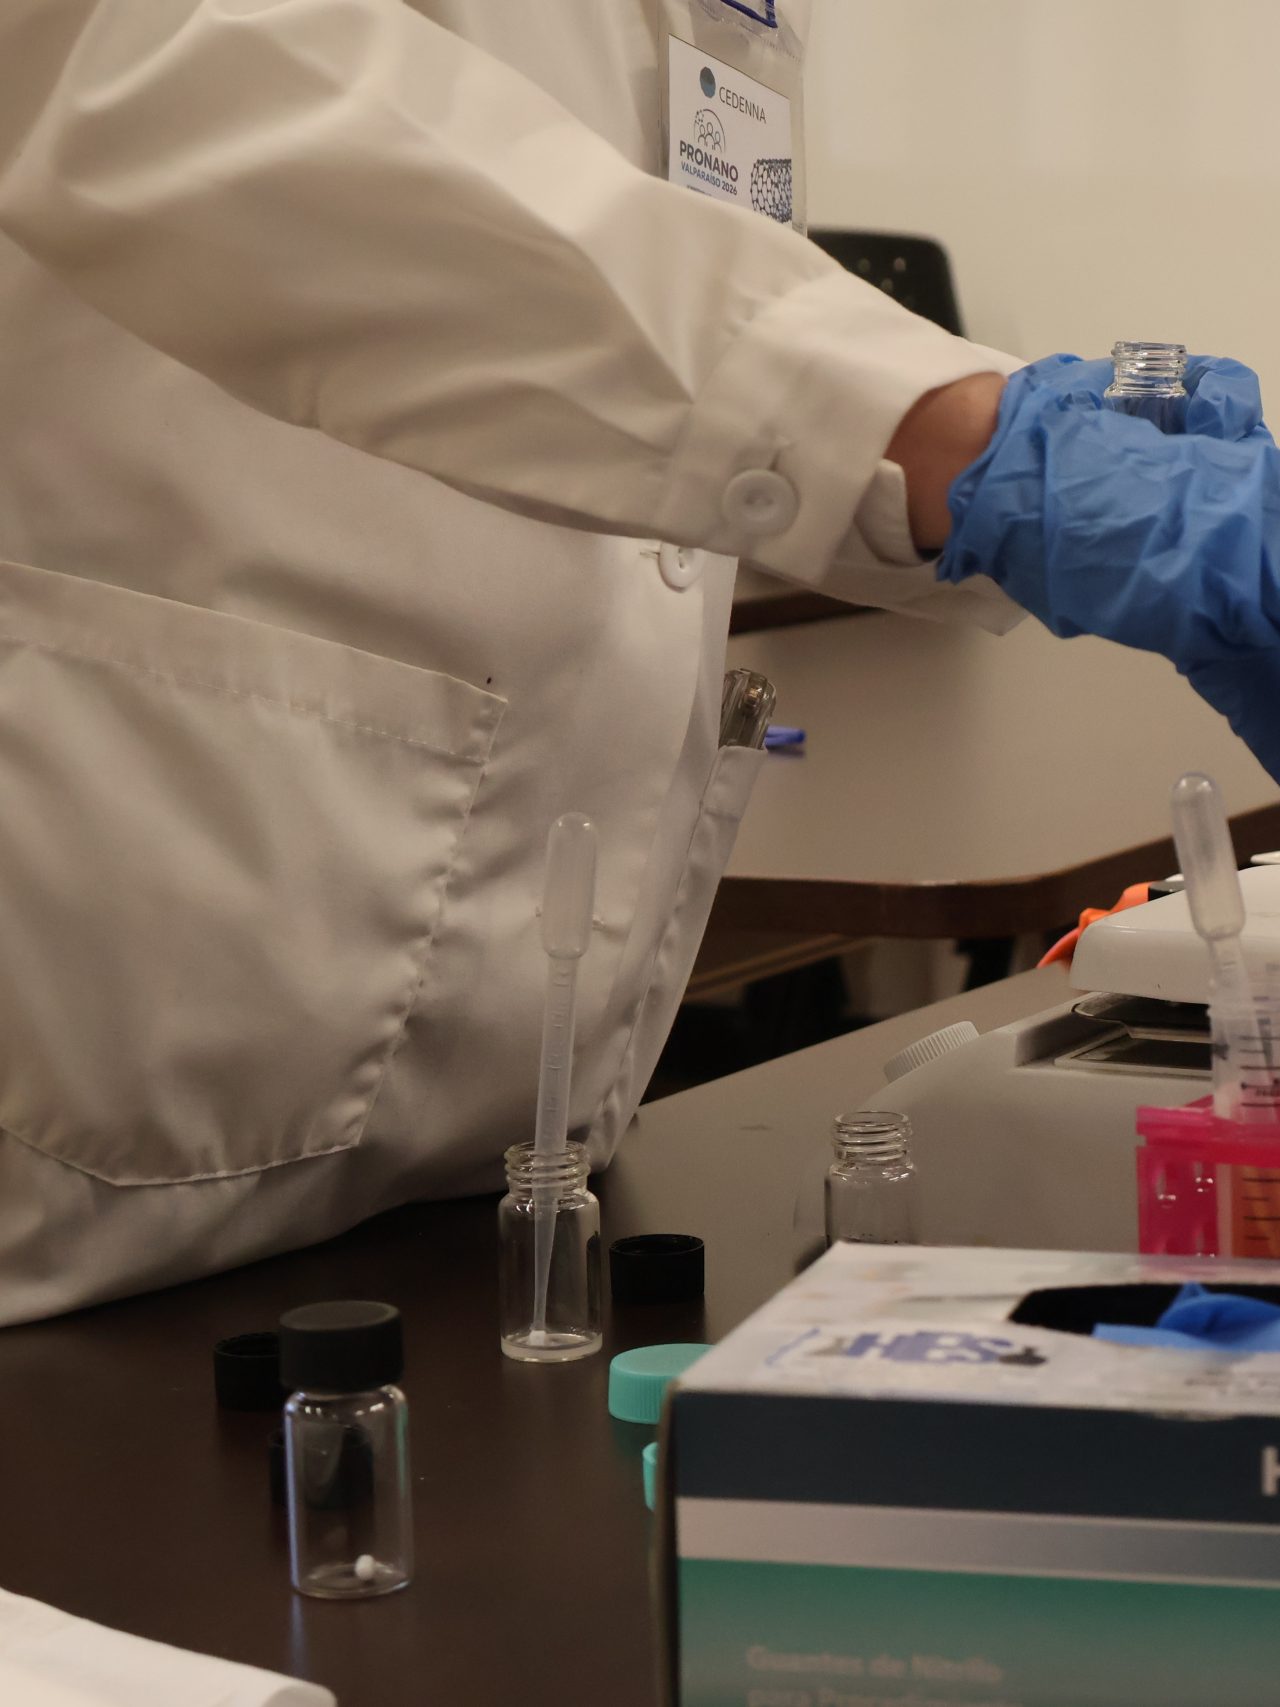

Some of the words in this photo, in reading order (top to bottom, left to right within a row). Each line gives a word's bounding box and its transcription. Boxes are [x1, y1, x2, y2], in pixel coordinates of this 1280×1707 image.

[719, 87, 767, 124] CEDENNA
[680, 140, 739, 183] PRONANO
[722, 180, 738, 196] 2026
